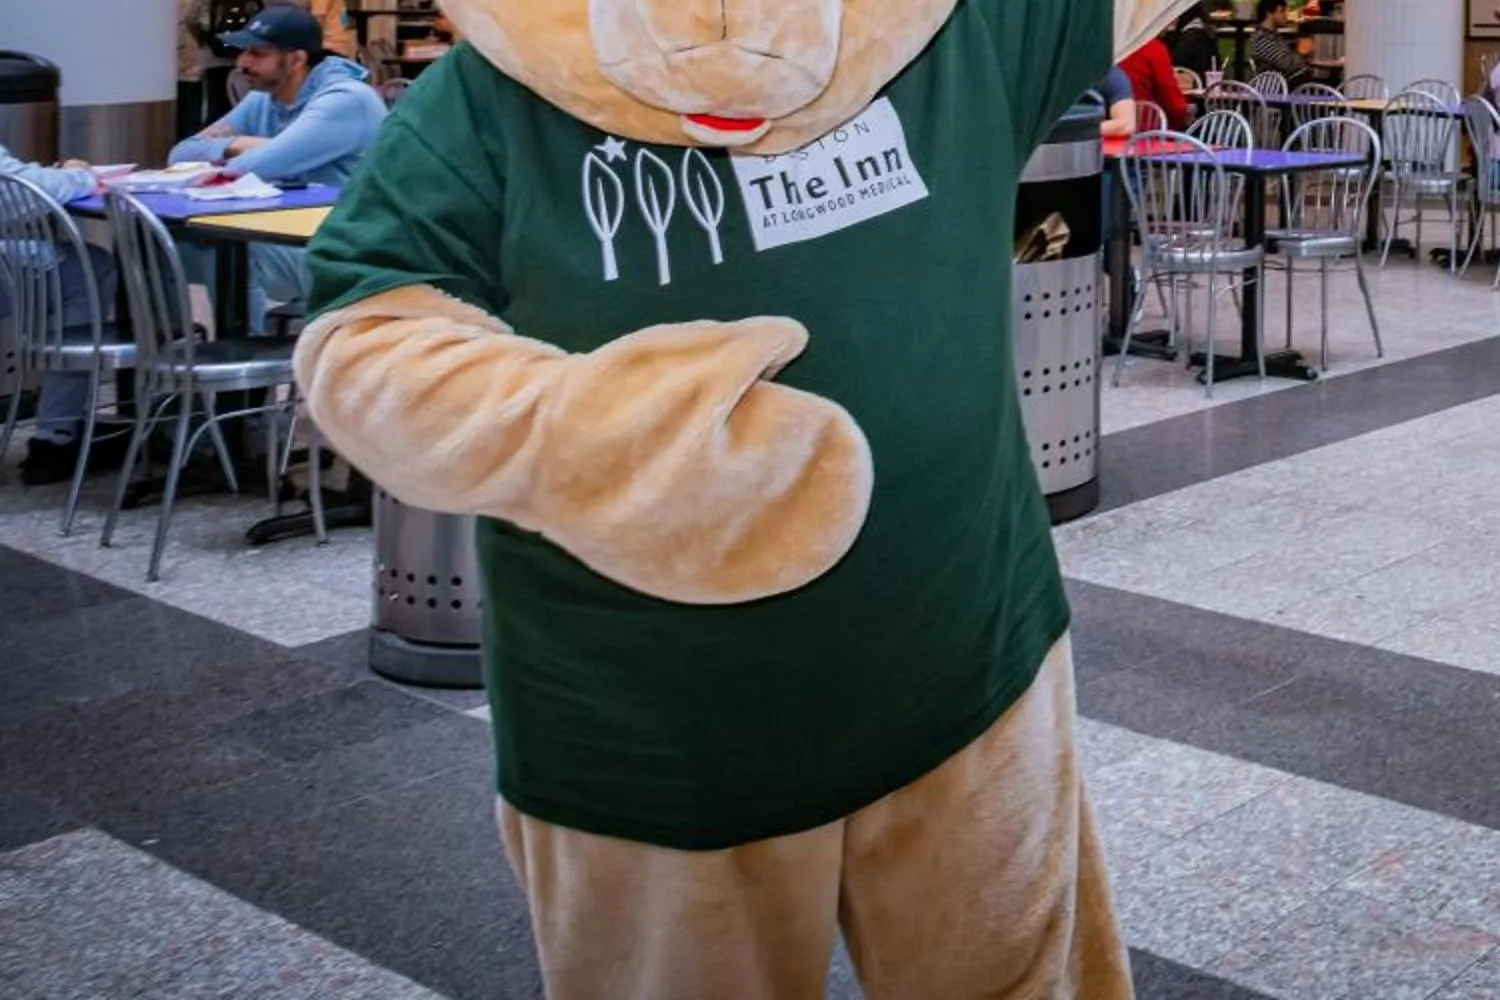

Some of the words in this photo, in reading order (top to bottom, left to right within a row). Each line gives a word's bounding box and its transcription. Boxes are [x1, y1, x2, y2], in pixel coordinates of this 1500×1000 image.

[764, 121, 870, 164] STON
[750, 170, 829, 210] The
[833, 147, 903, 189] Inn
[762, 212, 778, 229] AT
[782, 193, 856, 225] LONGWOOD
[858, 175, 912, 201] MEDICAL
